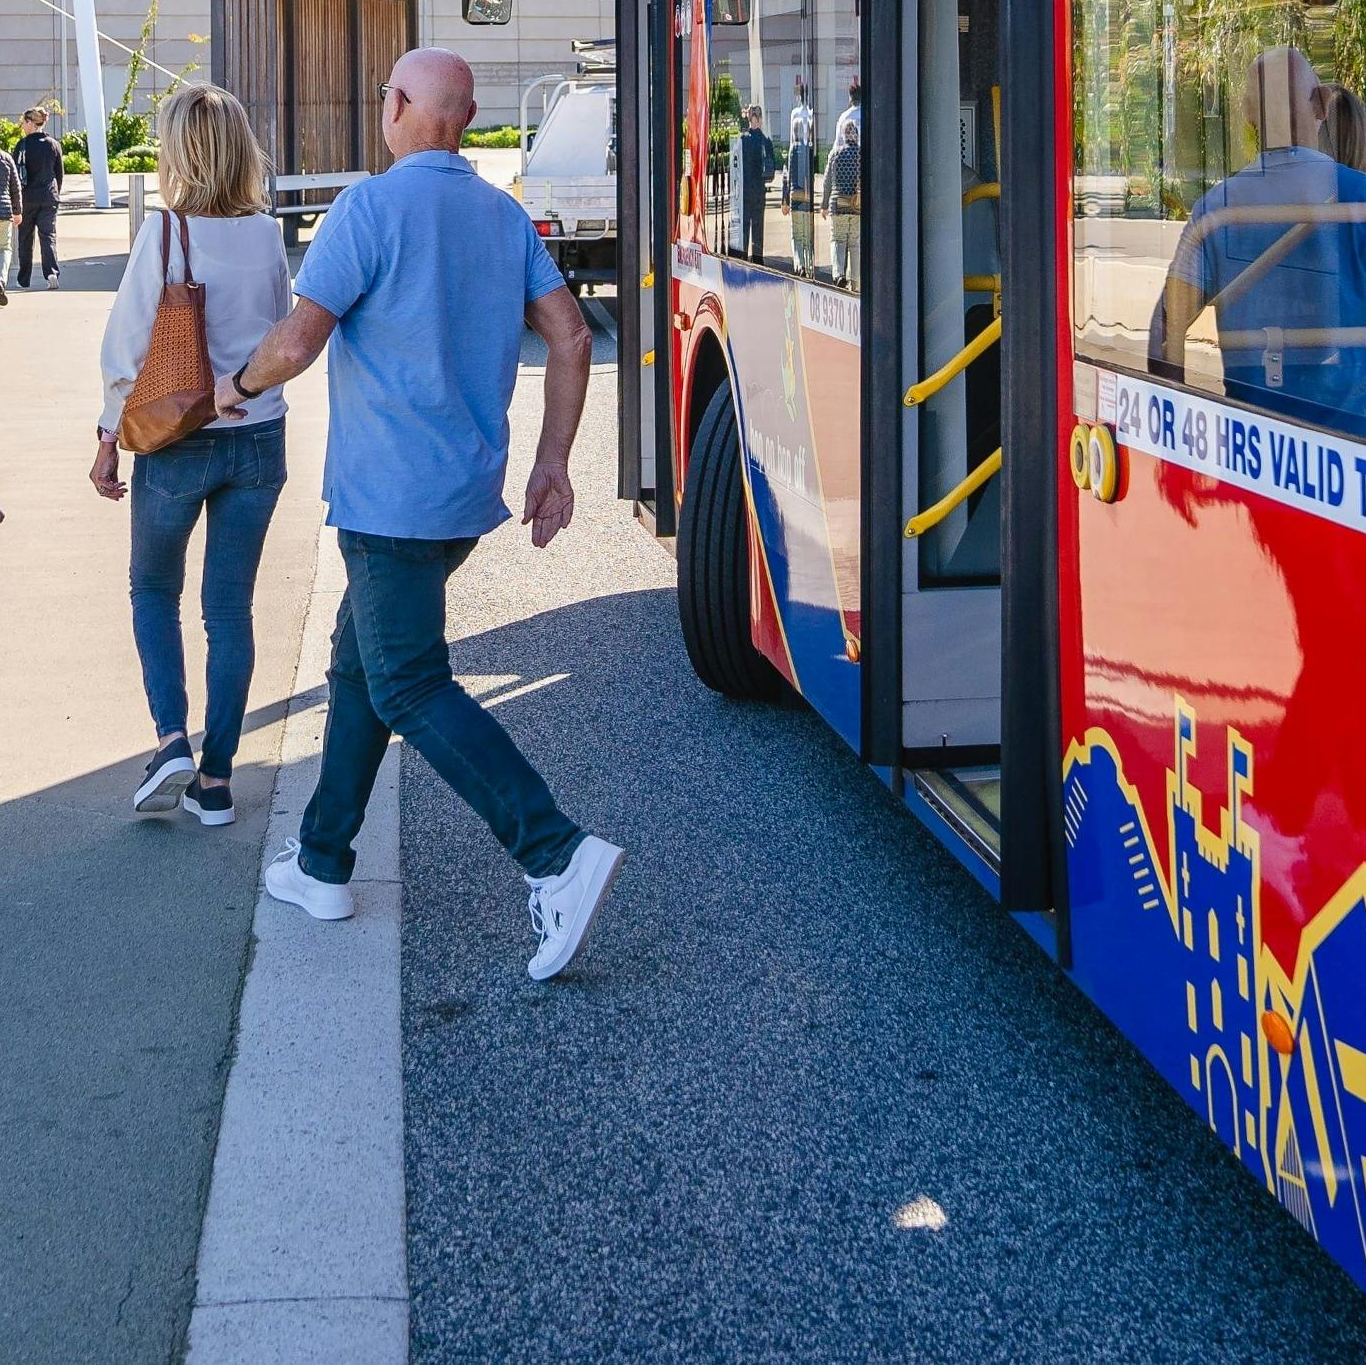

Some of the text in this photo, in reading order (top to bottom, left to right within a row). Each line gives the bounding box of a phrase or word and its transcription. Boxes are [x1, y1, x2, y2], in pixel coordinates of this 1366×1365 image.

[809, 291, 821, 323] 08
[822, 295, 845, 331] 9370
[750, 418, 764, 473] hop
[777, 435, 792, 490] hop
[794, 444, 806, 492] off
[1119, 387, 1141, 437] 24
[1148, 394, 1176, 451] OR
[1182, 407, 1208, 462] 48
[1215, 415, 1262, 480] HRS
[1269, 430, 1344, 507] VALID
